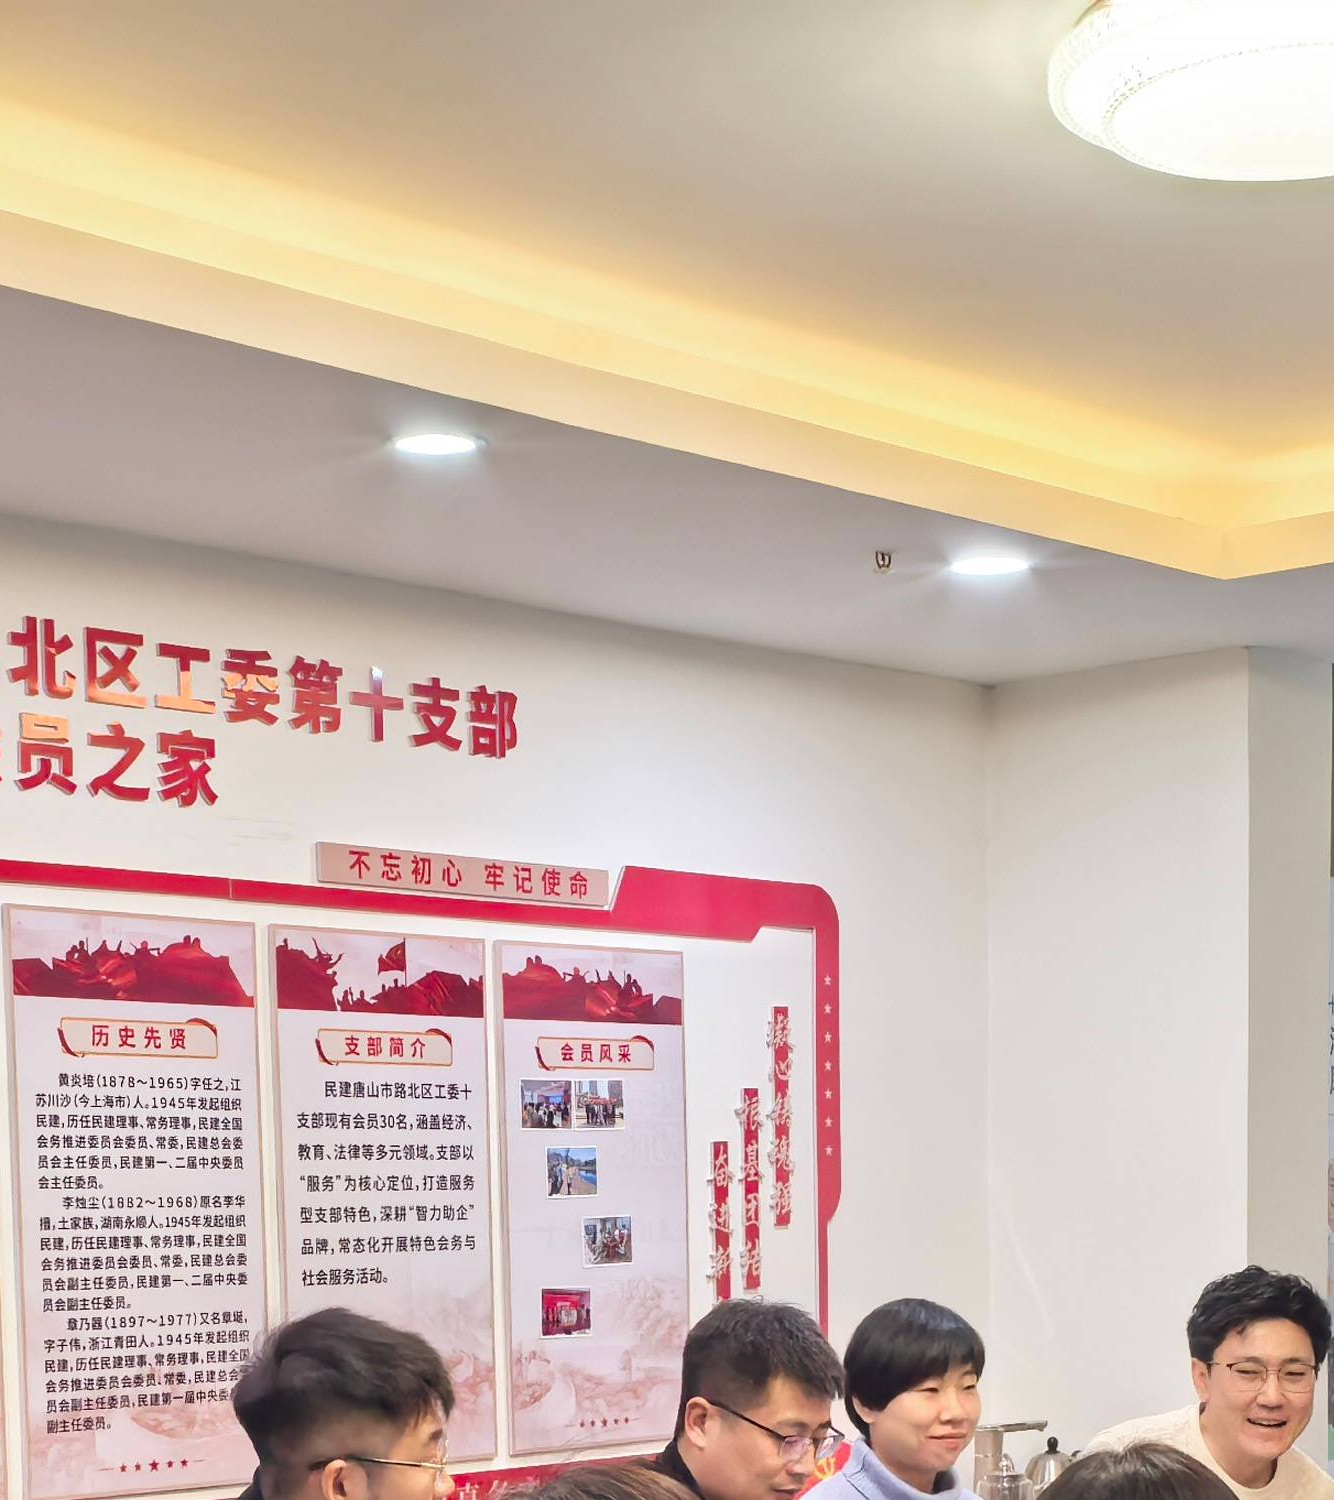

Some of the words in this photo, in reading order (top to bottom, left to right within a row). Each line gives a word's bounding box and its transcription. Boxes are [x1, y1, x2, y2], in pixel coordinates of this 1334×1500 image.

[348, 849, 463, 886] 不忘初心
[484, 863, 590, 899] 牢记使命
[92, 1024, 186, 1050] 历史先贤
[345, 1036, 426, 1058] 支部简介
[560, 1042, 632, 1063] 会员风采
[325, 1081, 471, 1100] 民建唐山市路北区工委十
[708, 1146, 733, 1303] 奋进新
[45, 1370, 242, 1393] 会务推进委员会委员、常委，民建总会
[46, 1389, 230, 1413] 员会副主任委员，民建第一届中央委
